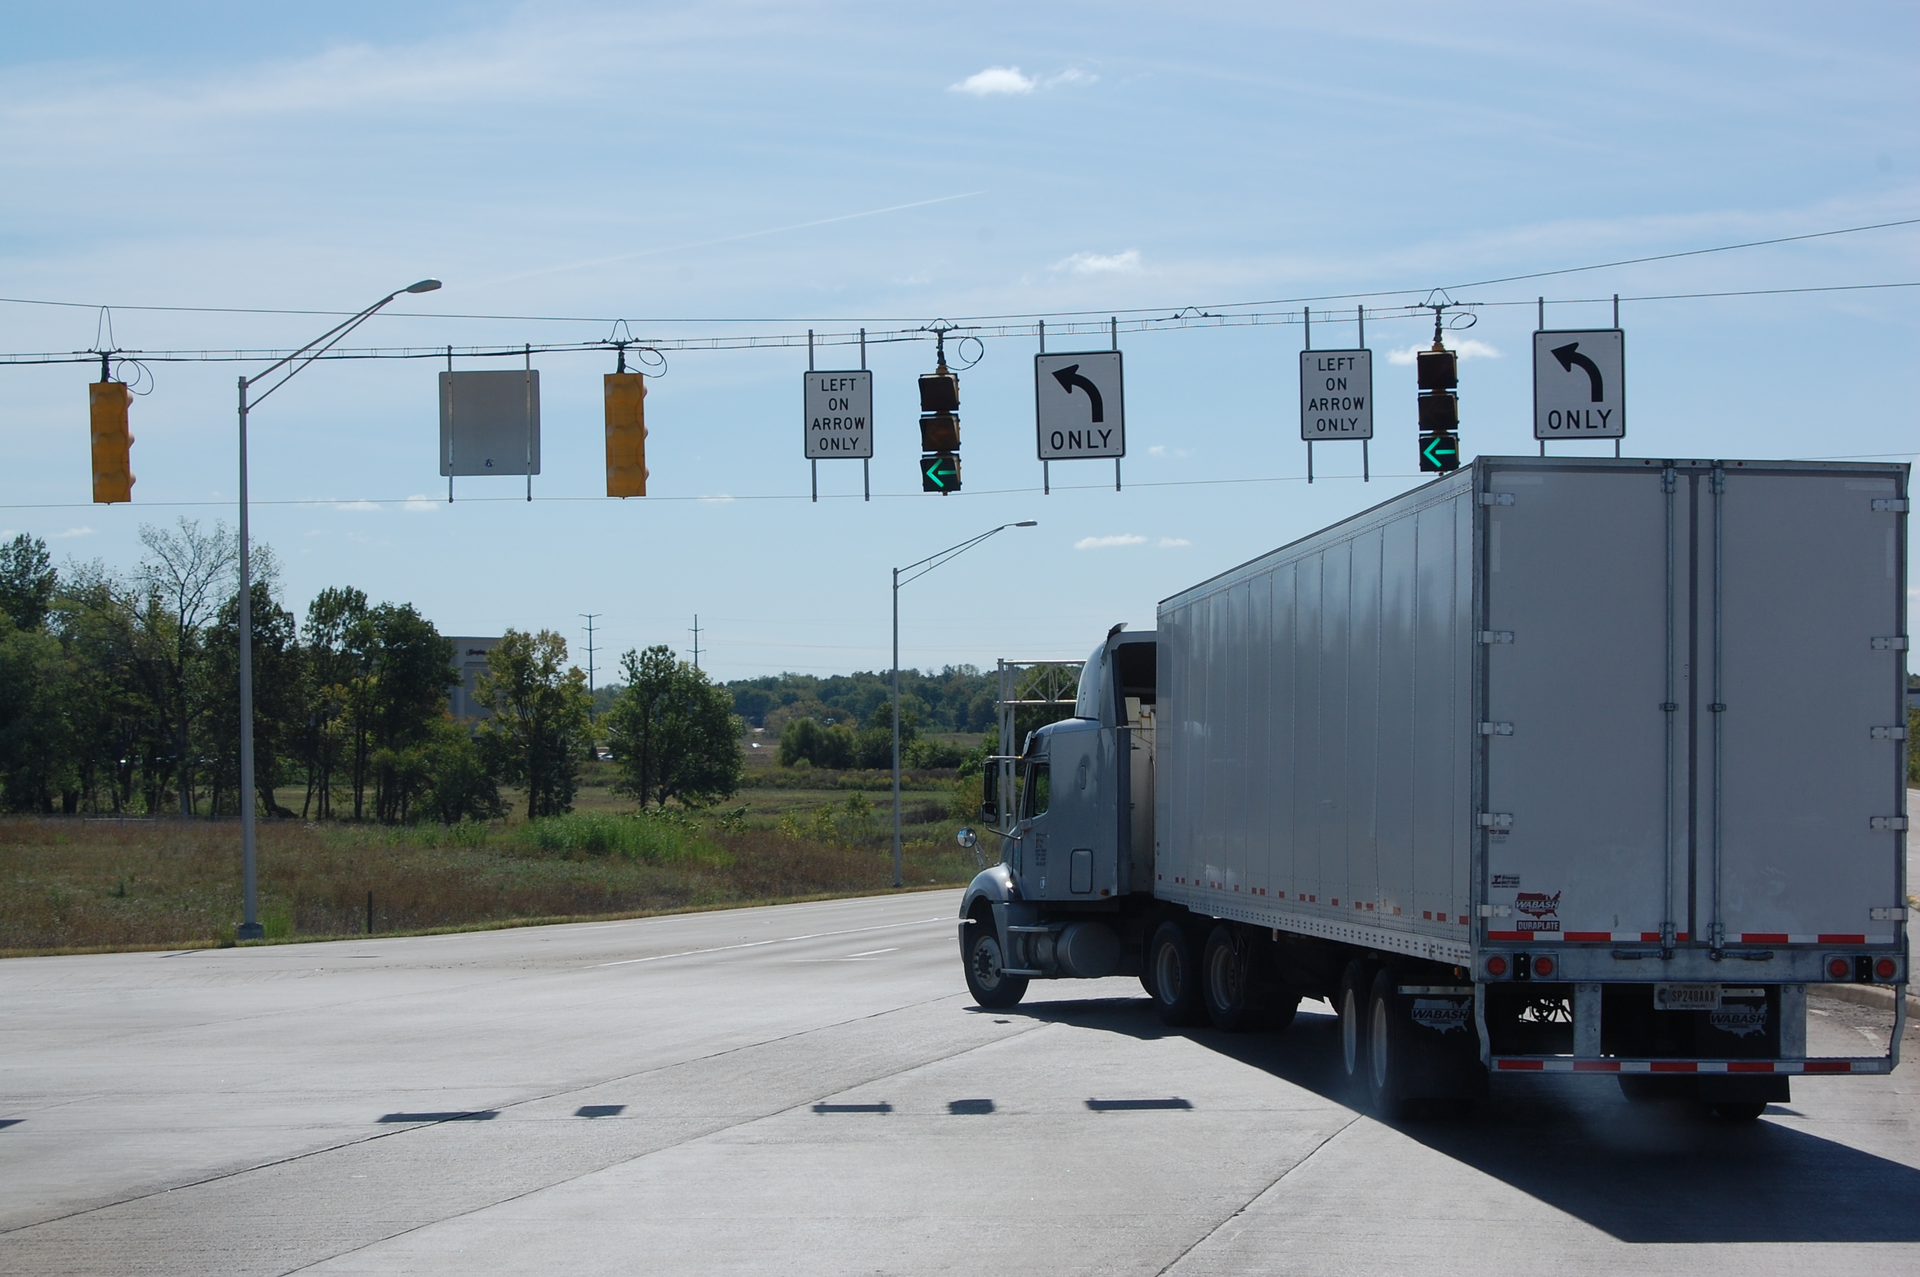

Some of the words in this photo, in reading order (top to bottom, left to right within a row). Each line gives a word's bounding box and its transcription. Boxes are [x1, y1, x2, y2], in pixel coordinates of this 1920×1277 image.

[1317, 357, 1355, 371] LEFT
[821, 378, 856, 392] LEFT
[1325, 377, 1347, 391] ON
[828, 398, 849, 411] ON
[1308, 396, 1365, 411] ARROW
[811, 417, 865, 431] ARROW
[1316, 418, 1359, 432] ONLY
[1547, 409, 1613, 430] ONLY
[819, 437, 860, 451] ONLY
[1050, 429, 1113, 450] ONLY
[1515, 900, 1560, 909] WABASH
[1517, 921, 1559, 930] DURAPLATE
[1671, 990, 1715, 1002] SP248AAX
[1412, 1010, 1469, 1019] WABASH
[1711, 1014, 1766, 1023] WABASH
